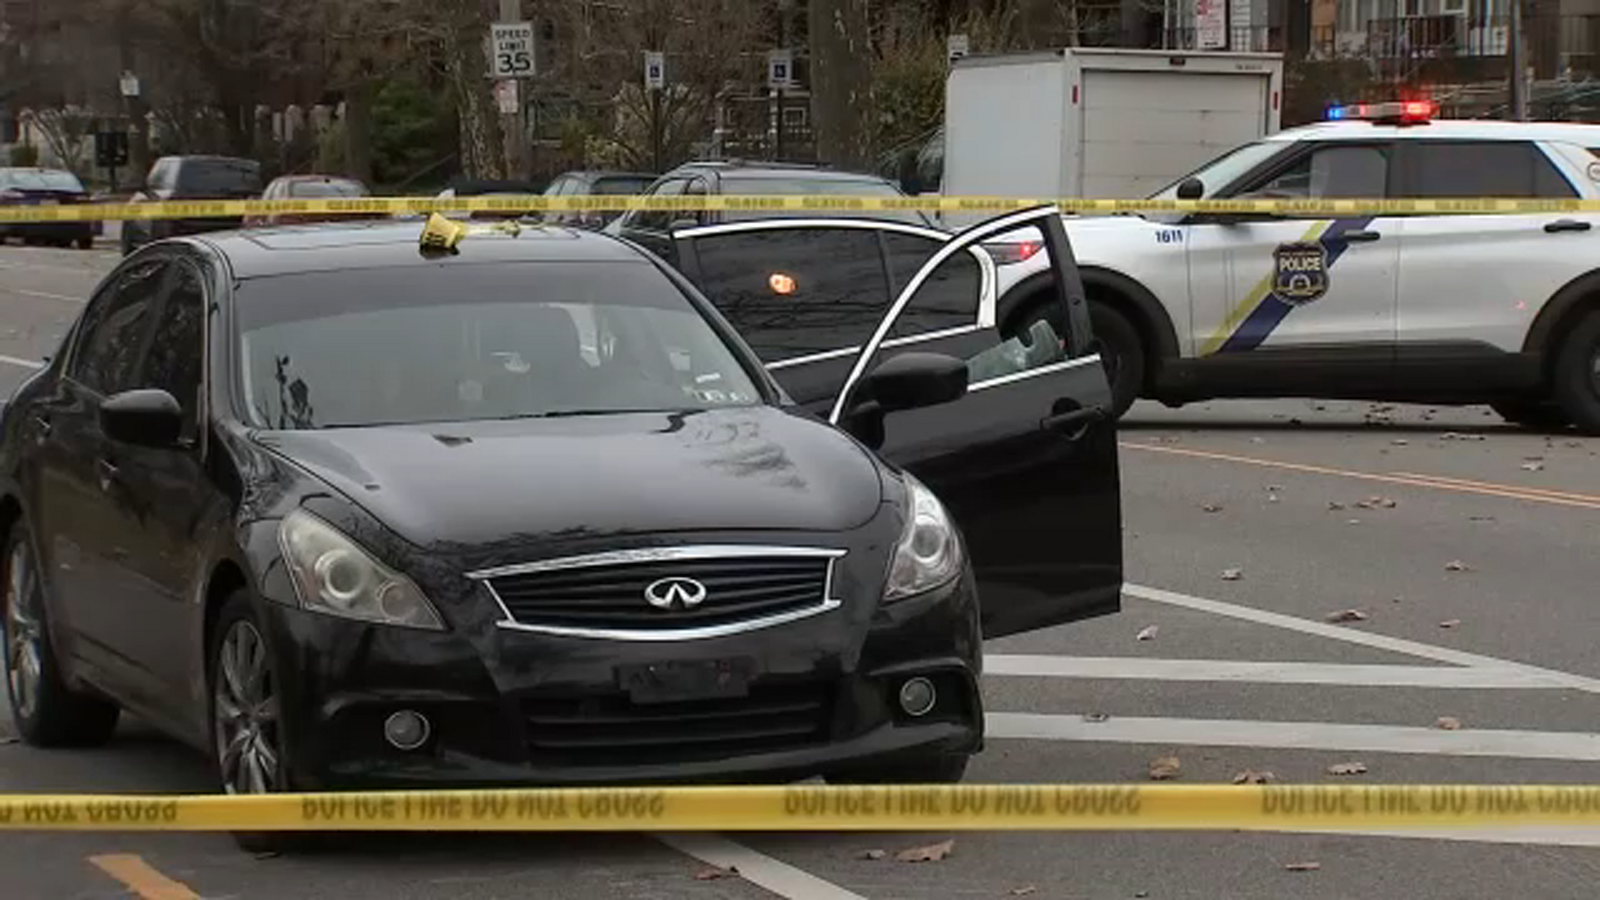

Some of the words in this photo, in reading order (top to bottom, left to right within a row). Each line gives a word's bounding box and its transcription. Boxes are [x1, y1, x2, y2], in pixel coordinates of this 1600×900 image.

[495, 30, 530, 39] SPEED
[499, 40, 526, 51] LIMIT
[497, 52, 531, 73] 35
[1155, 230, 1183, 243] 1611
[1279, 257, 1321, 271] POLICE
